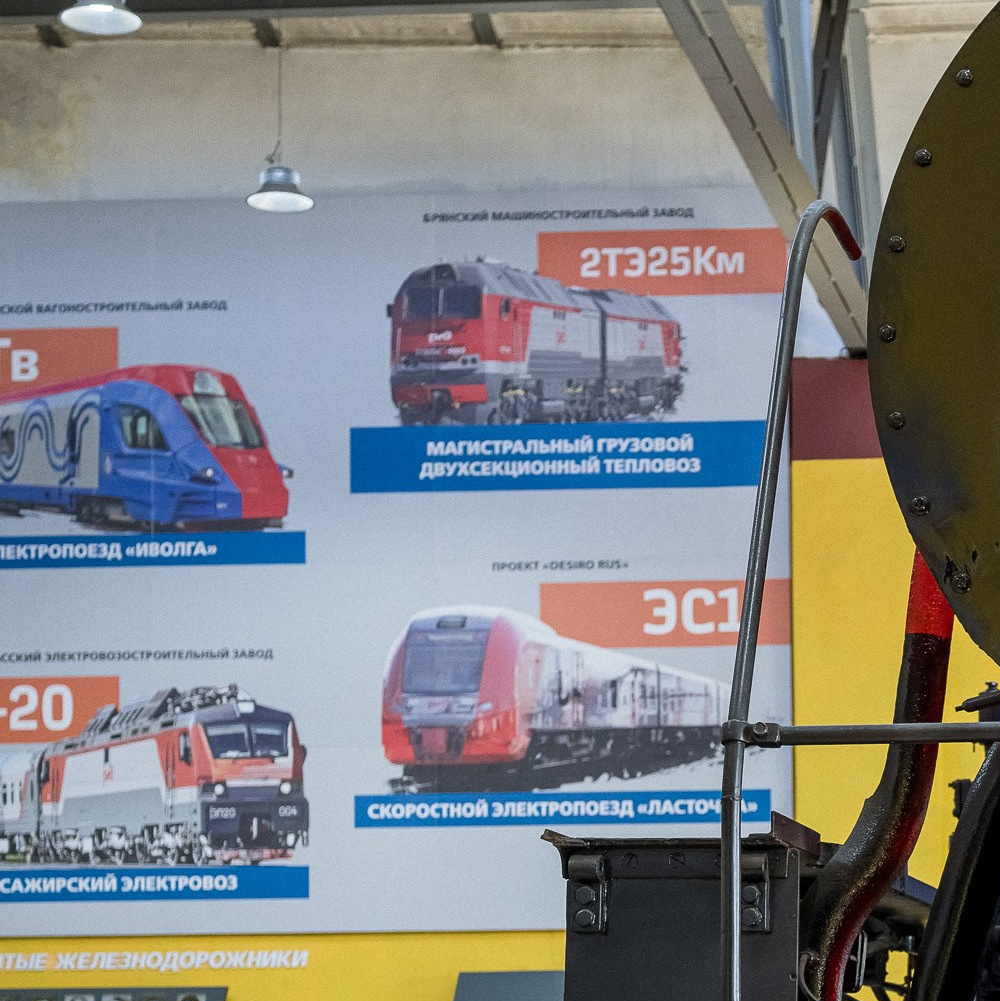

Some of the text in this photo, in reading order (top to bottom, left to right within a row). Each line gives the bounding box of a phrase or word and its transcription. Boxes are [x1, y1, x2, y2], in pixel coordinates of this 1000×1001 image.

[422, 207, 695, 223] БРЯНСКИЙ МАШИНОСТРОИТЕЛЬНЫЙ ЗАВОД
[36, 299, 184, 314] ВАГОНОСТРОИТЕЛЬНЫЙ
[187, 299, 228, 312] ЗАВОД
[426, 433, 695, 457] МАГИСТРАЛЬНЫЙ ГРУЗОВОЙ
[418, 456, 702, 480] ДВУХСЕКЦИОННЫЙ ТЕПЛОВОЗ
[125, 540, 218, 558] «ИВОЛГА»
[491, 558, 629, 572] ПРОЕКТ «DESIRO RUS»
[642, 587, 741, 636] ЭС1
[45, 649, 230, 662] ЭЛЕКТРОВОЗОСТРОИТЕЛЬНЫЙ
[233, 649, 274, 661] ЗАВОД
[367, 797, 758, 820] СКОРОСТНОЙ ЭЛЕКТРОПОЕЗД «ЛАСТОЧ»
[0, 873, 239, 894] САЖИРСКИЙ ЭЛЕКТРОВОЗ
[0, 950, 310, 973] ТЫЕ ЖЕЛЕЗНОДОРОЖНИКИ
